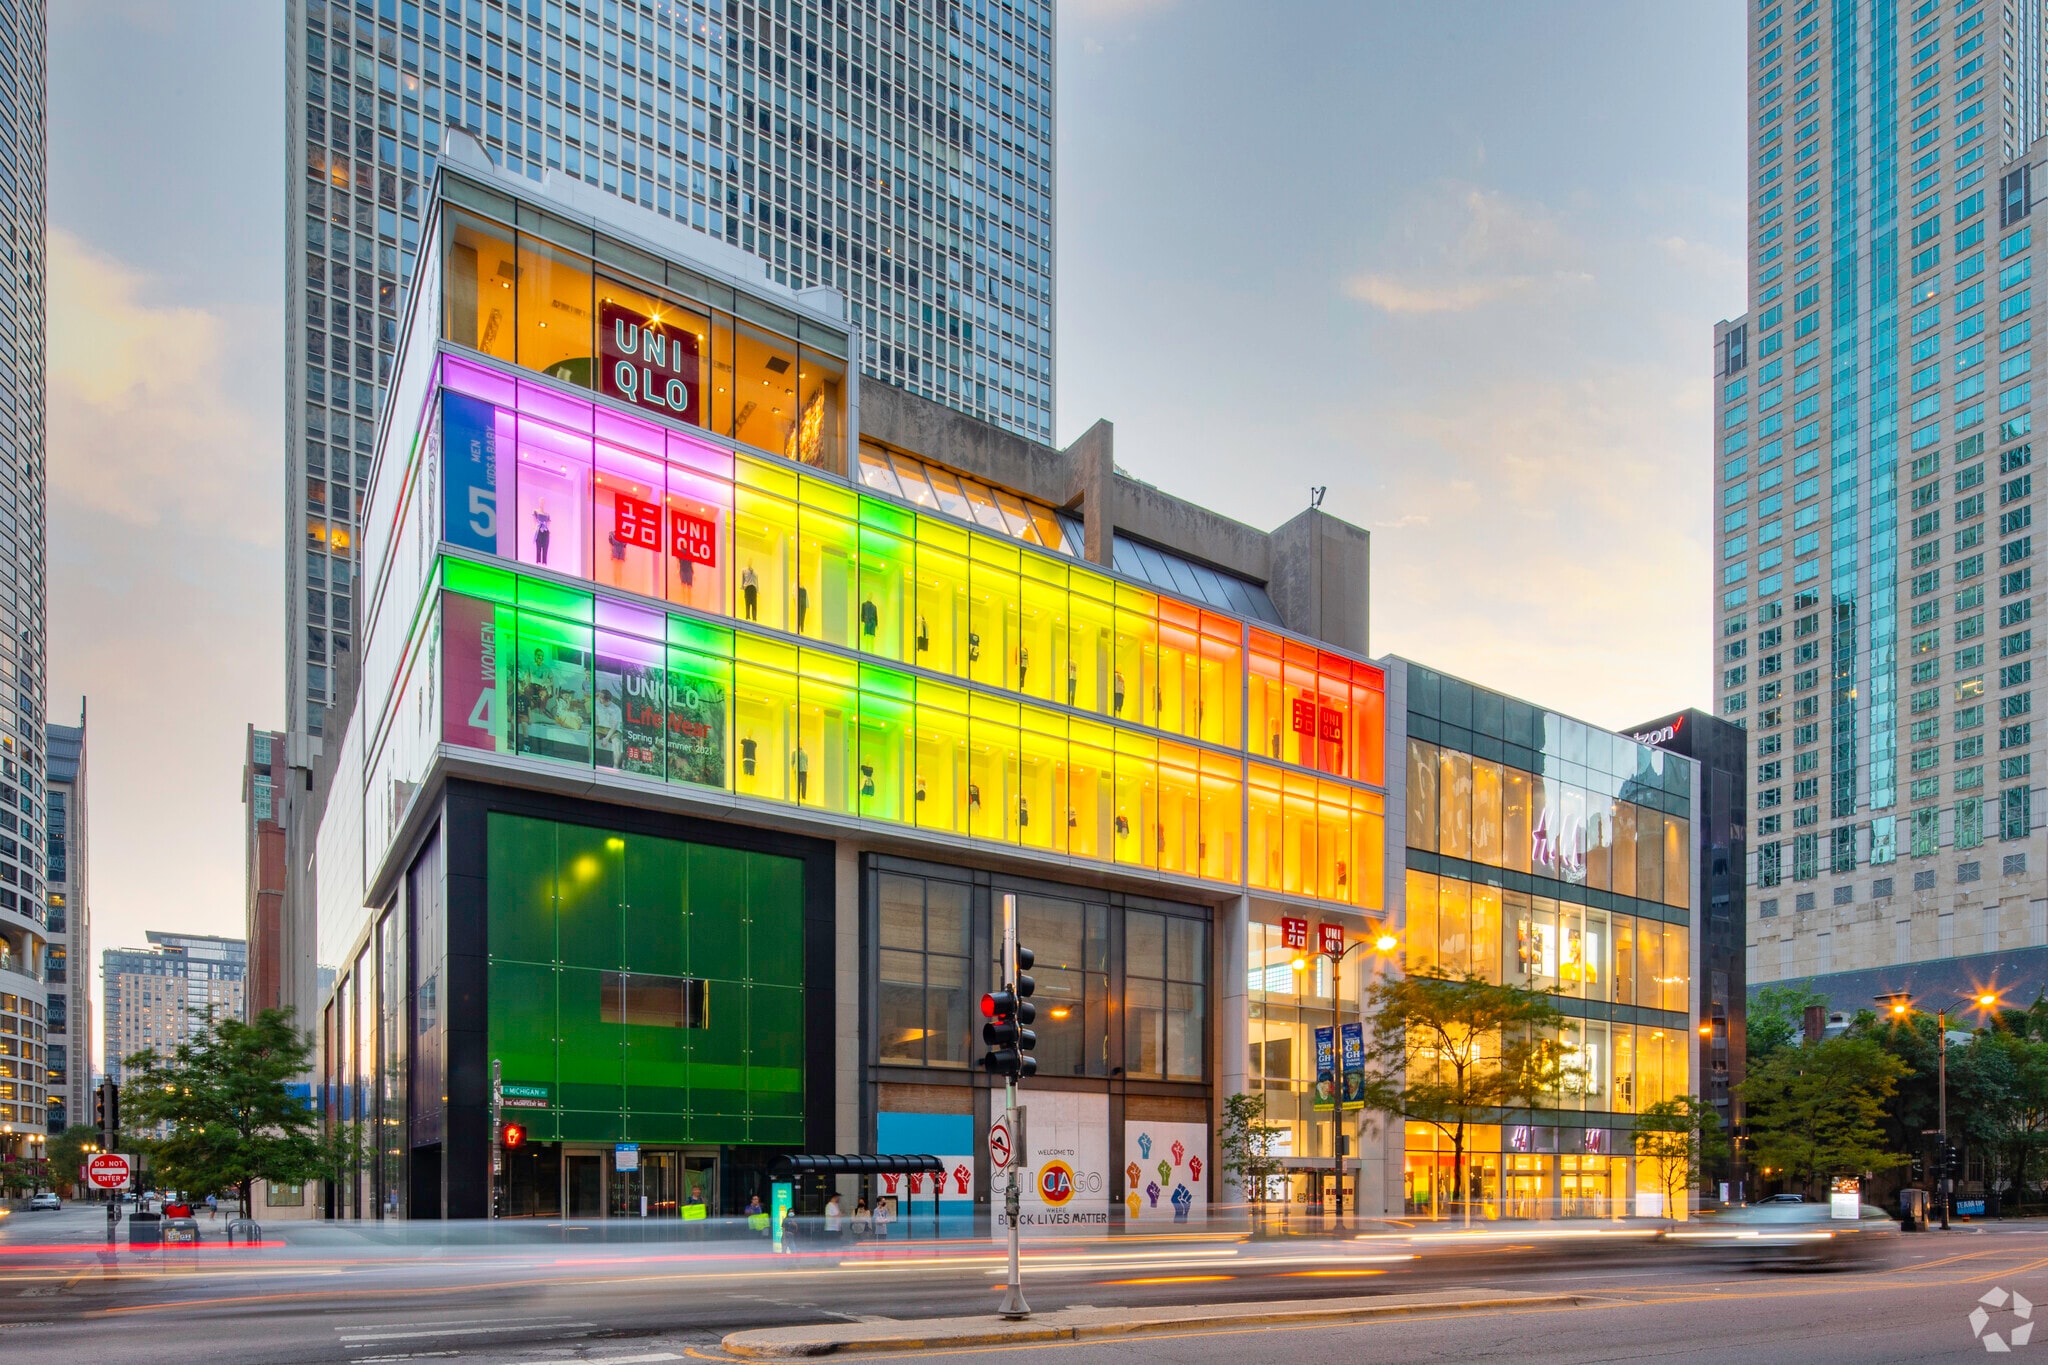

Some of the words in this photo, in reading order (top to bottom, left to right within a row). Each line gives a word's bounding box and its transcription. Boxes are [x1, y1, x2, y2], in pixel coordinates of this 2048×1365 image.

[615, 318, 681, 373] UNI
[615, 361, 688, 412] QLO
[470, 439, 481, 463] MEN
[468, 485, 496, 538] 5
[621, 502, 656, 525] ユニ
[620, 521, 656, 545] クロ
[677, 518, 708, 542] UNI
[677, 537, 711, 560] QLO
[481, 621, 495, 680] WOMEN
[626, 674, 699, 710] UNIQLO
[468, 687, 496, 737] 4
[1323, 711, 1339, 727] UNI
[627, 730, 653, 745] Spring
[695, 745, 712, 756] 2021
[1323, 725, 1341, 739] QLO
[1325, 927, 1341, 940] UNI
[510, 1088, 539, 1096] MICHIGAN
[998, 1213, 1035, 1225] BLCK
[1038, 1213, 1070, 1225] LIVES
[1071, 1213, 1107, 1224] MATTER
